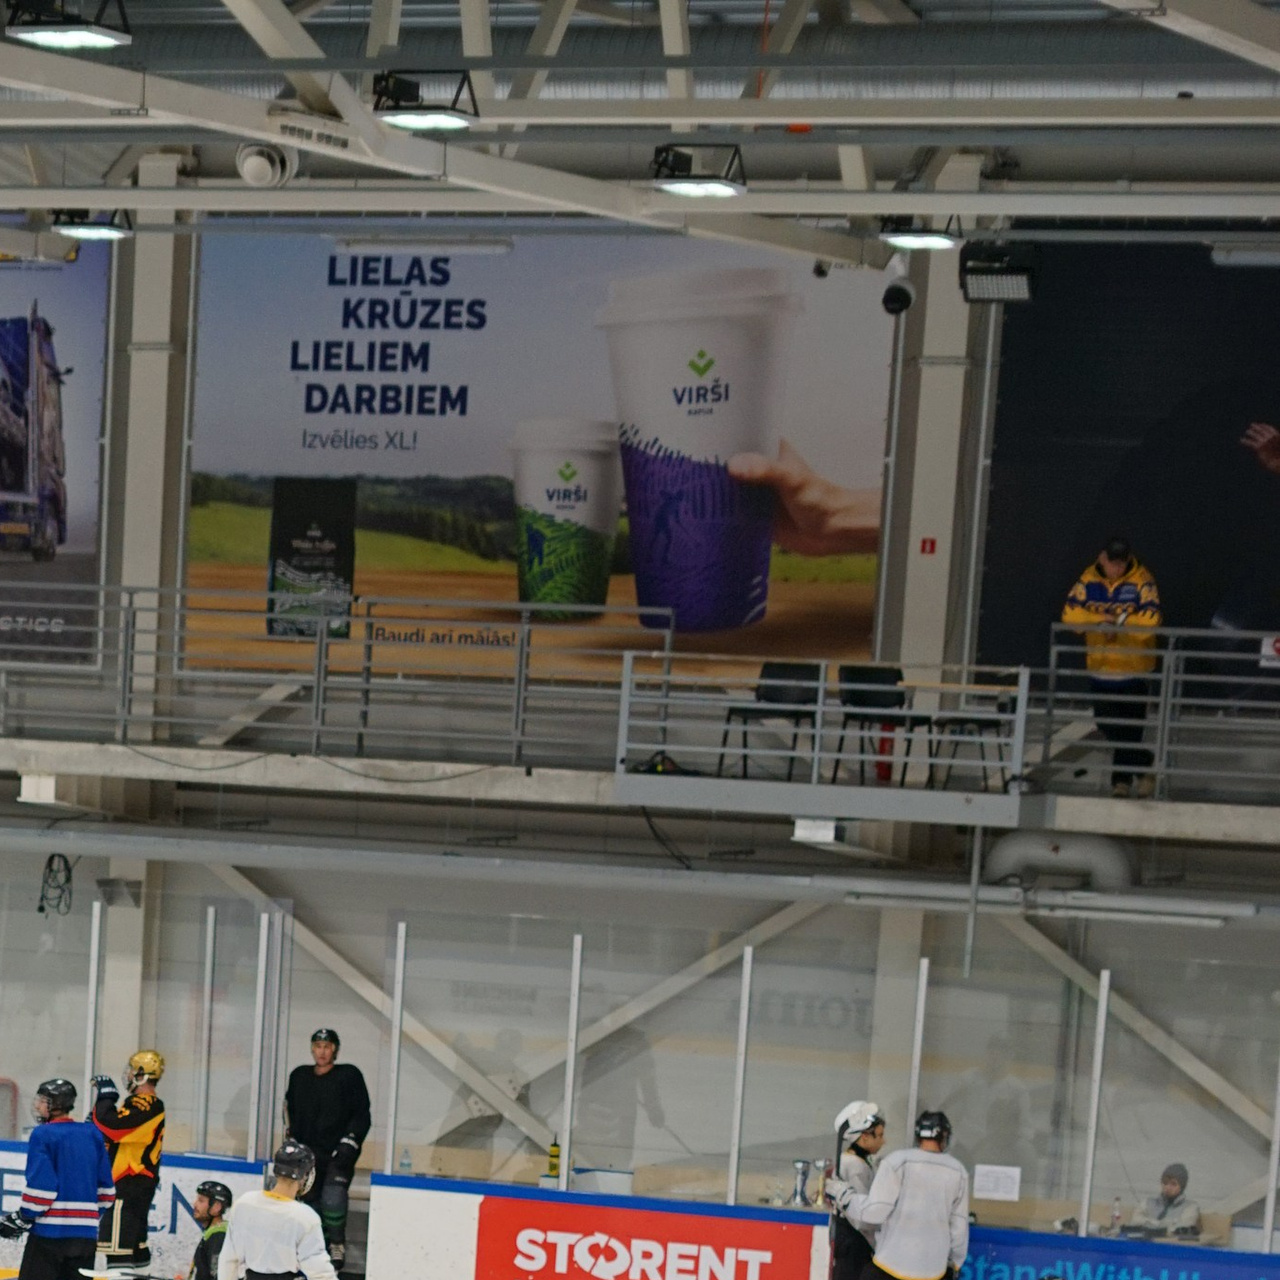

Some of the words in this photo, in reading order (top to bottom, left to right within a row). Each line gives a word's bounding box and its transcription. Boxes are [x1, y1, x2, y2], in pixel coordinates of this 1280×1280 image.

[328, 255, 451, 287] LIELAS
[341, 290, 488, 331] KRŪZES
[290, 340, 431, 373] LIELIEM
[304, 383, 469, 416] DARBIEM
[672, 377, 730, 405] VIRŠI
[301, 428, 379, 450] Izvēlies
[383, 430, 418, 451] XL!
[545, 484, 588, 502] VIRŠI
